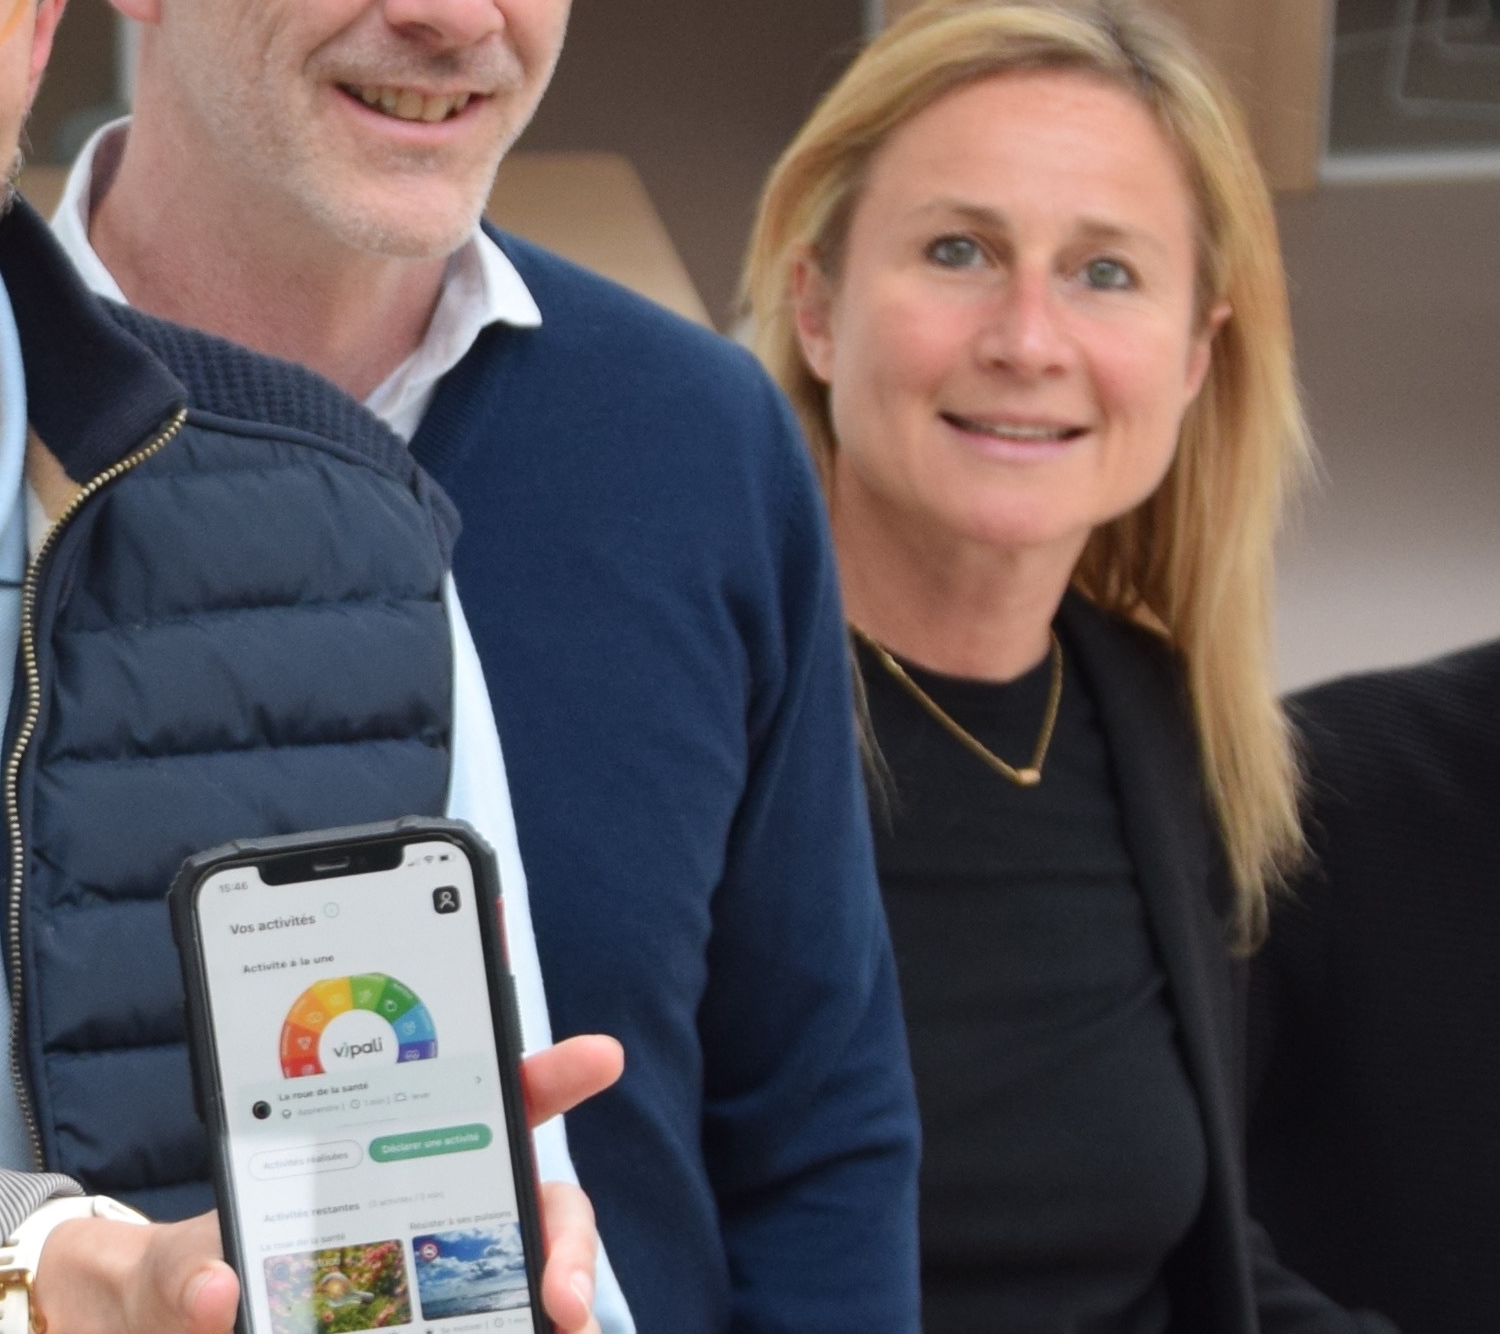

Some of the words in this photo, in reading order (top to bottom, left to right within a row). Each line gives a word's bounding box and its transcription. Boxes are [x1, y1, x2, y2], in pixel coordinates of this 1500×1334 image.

[219, 881, 248, 894] 15:46
[230, 922, 255, 936] Vos
[258, 914, 316, 931] activités
[314, 955, 334, 965] une
[333, 1037, 383, 1059] vipali
